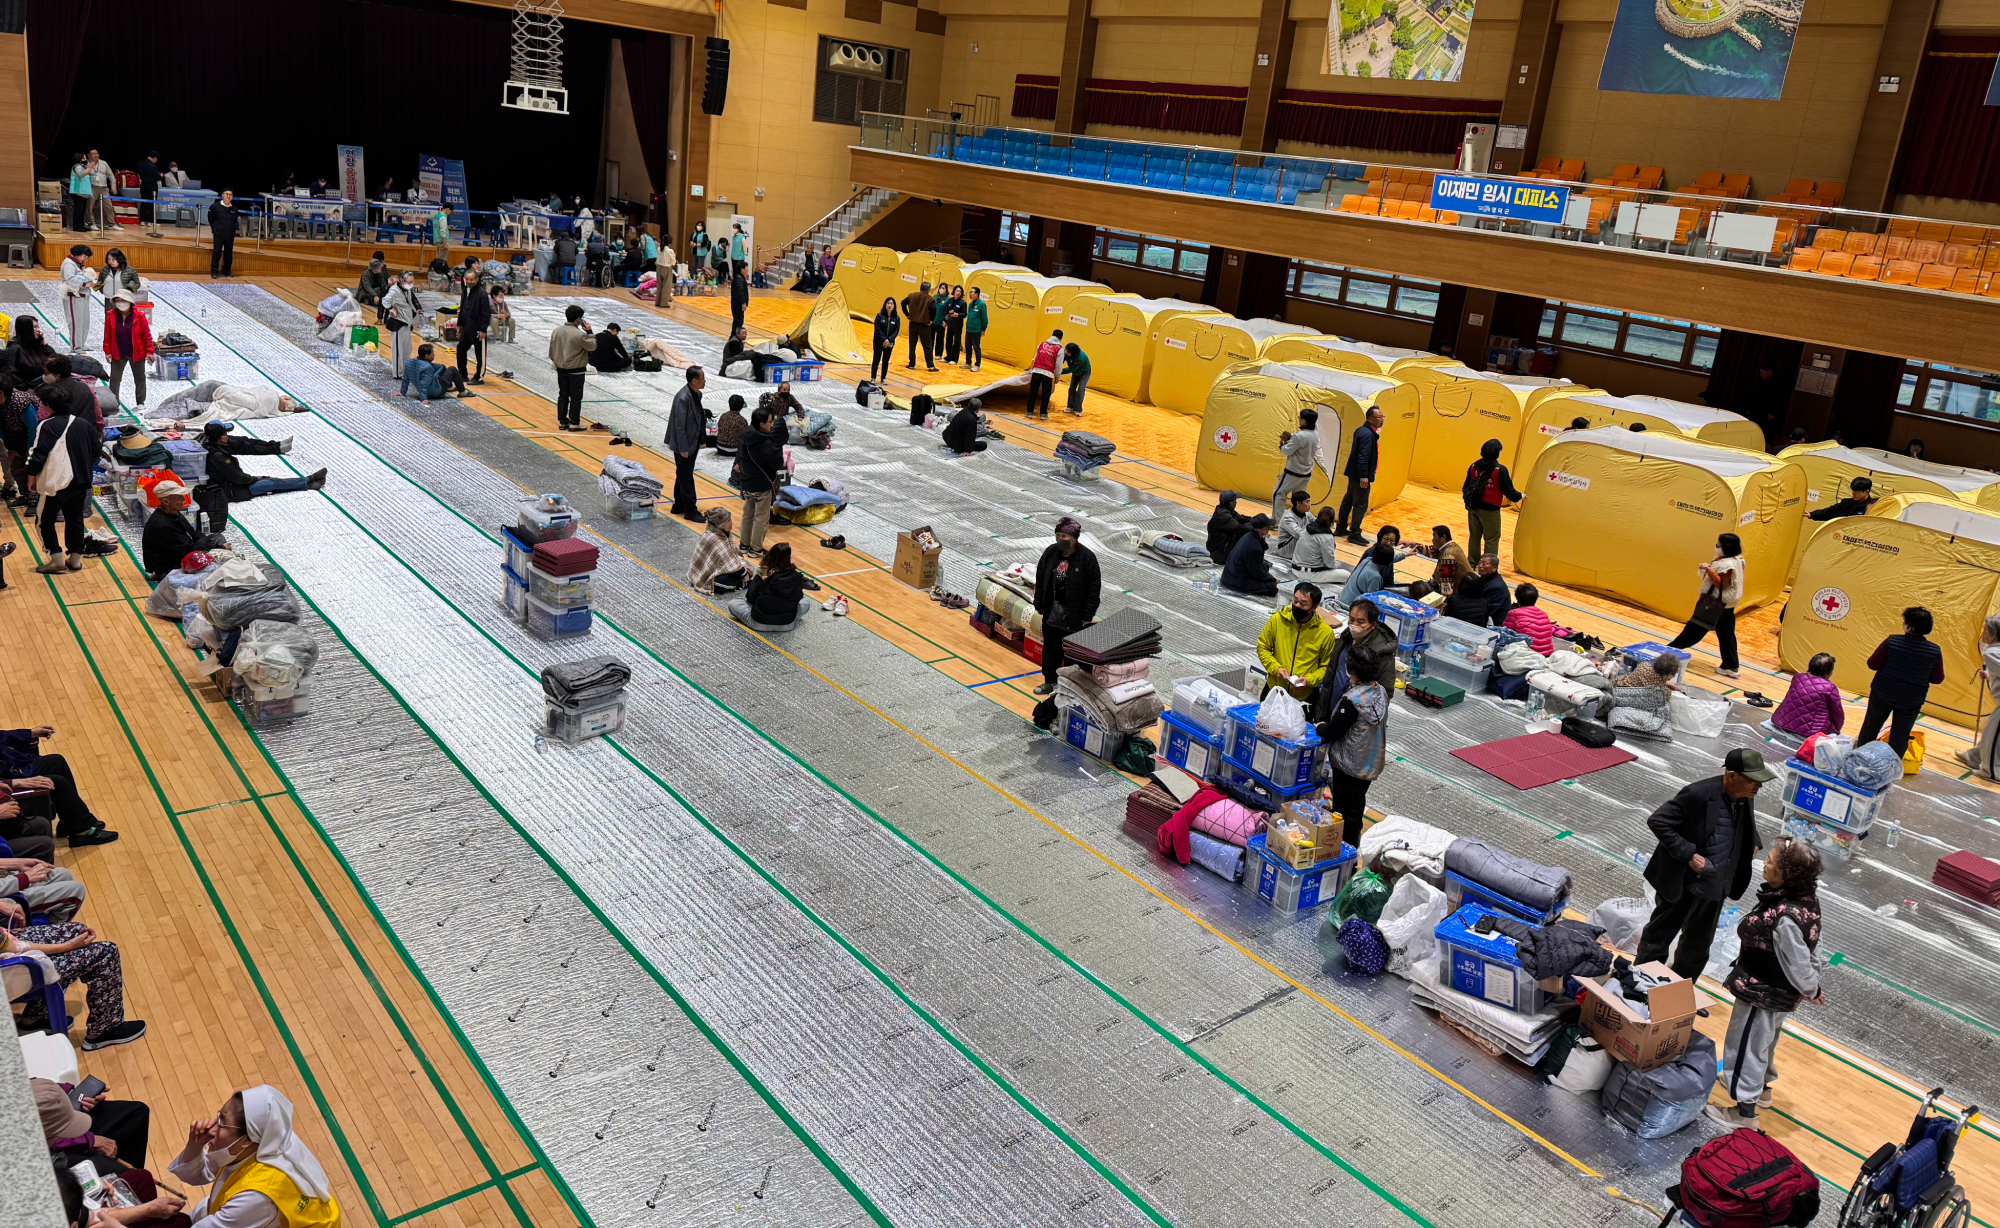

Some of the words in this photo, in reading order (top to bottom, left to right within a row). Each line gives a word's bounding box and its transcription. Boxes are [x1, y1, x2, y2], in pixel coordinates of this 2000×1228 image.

[345, 149, 355, 167] 현장
[445, 195, 465, 204] 보건소
[1438, 179, 1480, 200] 이재민
[1482, 184, 1512, 204] 임시
[1514, 187, 1560, 209] 대피소
[1815, 589, 1831, 601] KOREAN
[1803, 615, 1830, 627] Emergency
[1830, 622, 1848, 632] Shelter
[1594, 1001, 1622, 1022] 비트
[1656, 1032, 1679, 1053] 비트
